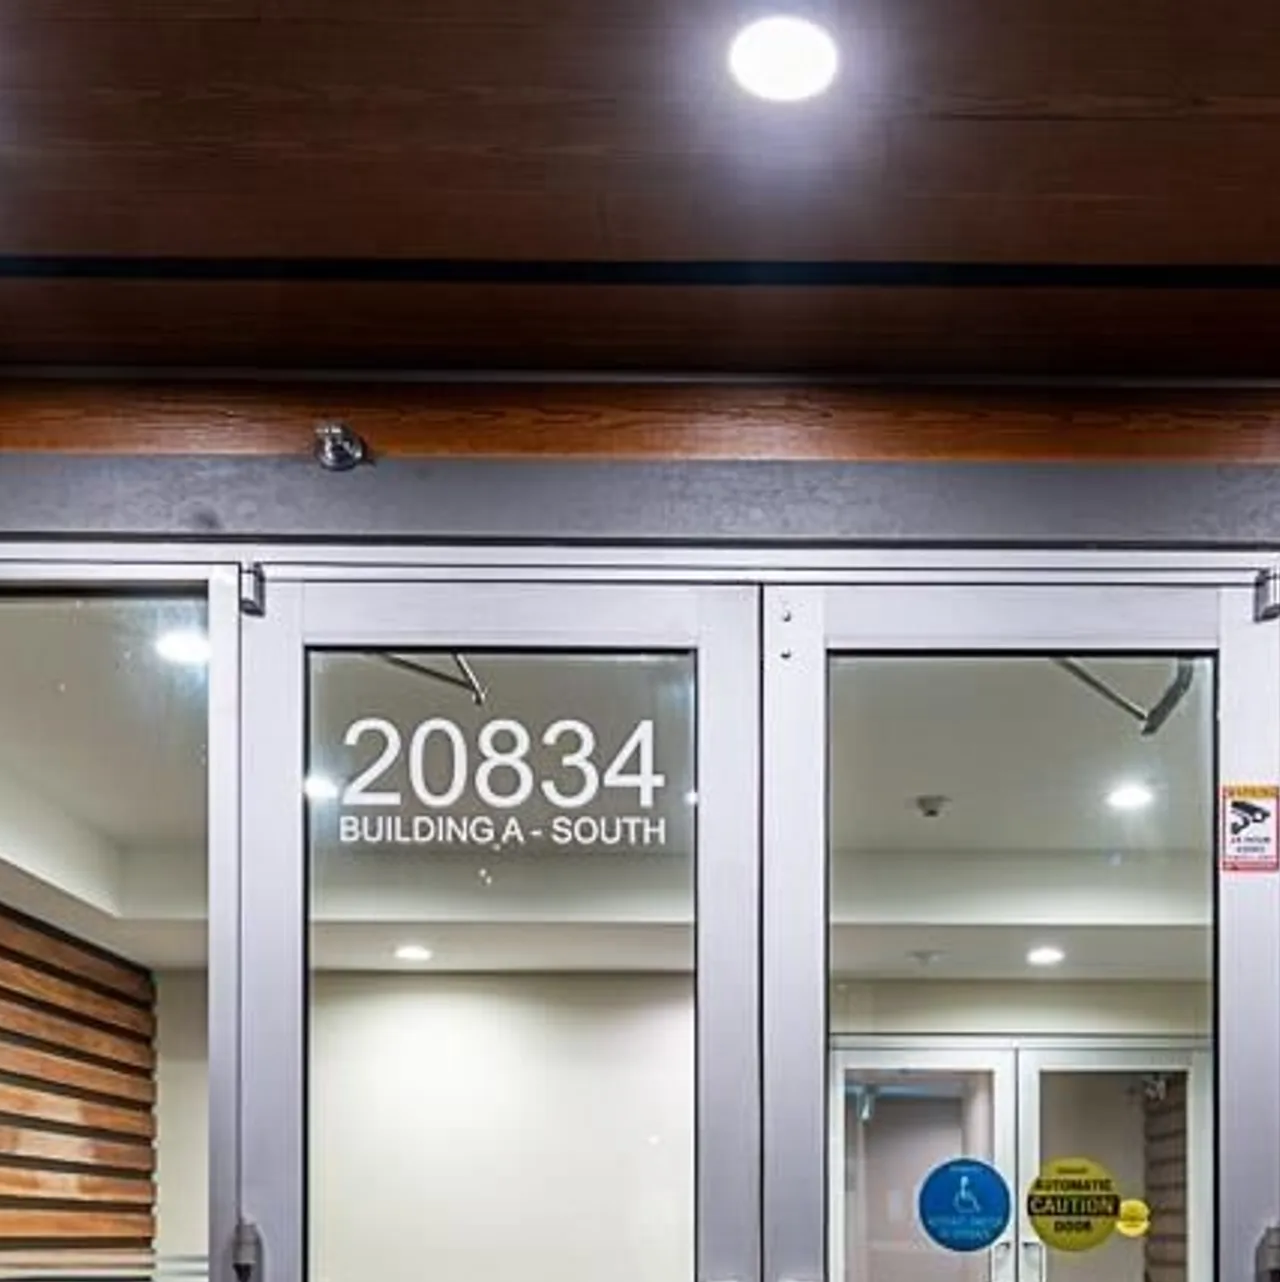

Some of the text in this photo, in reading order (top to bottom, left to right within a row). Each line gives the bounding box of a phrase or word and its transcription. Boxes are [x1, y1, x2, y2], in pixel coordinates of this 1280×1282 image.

[341, 717, 666, 809] 20834
[339, 815, 494, 843] BUILDING
[500, 816, 524, 843] A
[551, 815, 667, 844] SOUTH
[1034, 1178, 1112, 1192] AUTOMATIC
[1029, 1197, 1116, 1214] CAUTION
[1053, 1220, 1094, 1233] DOOR
